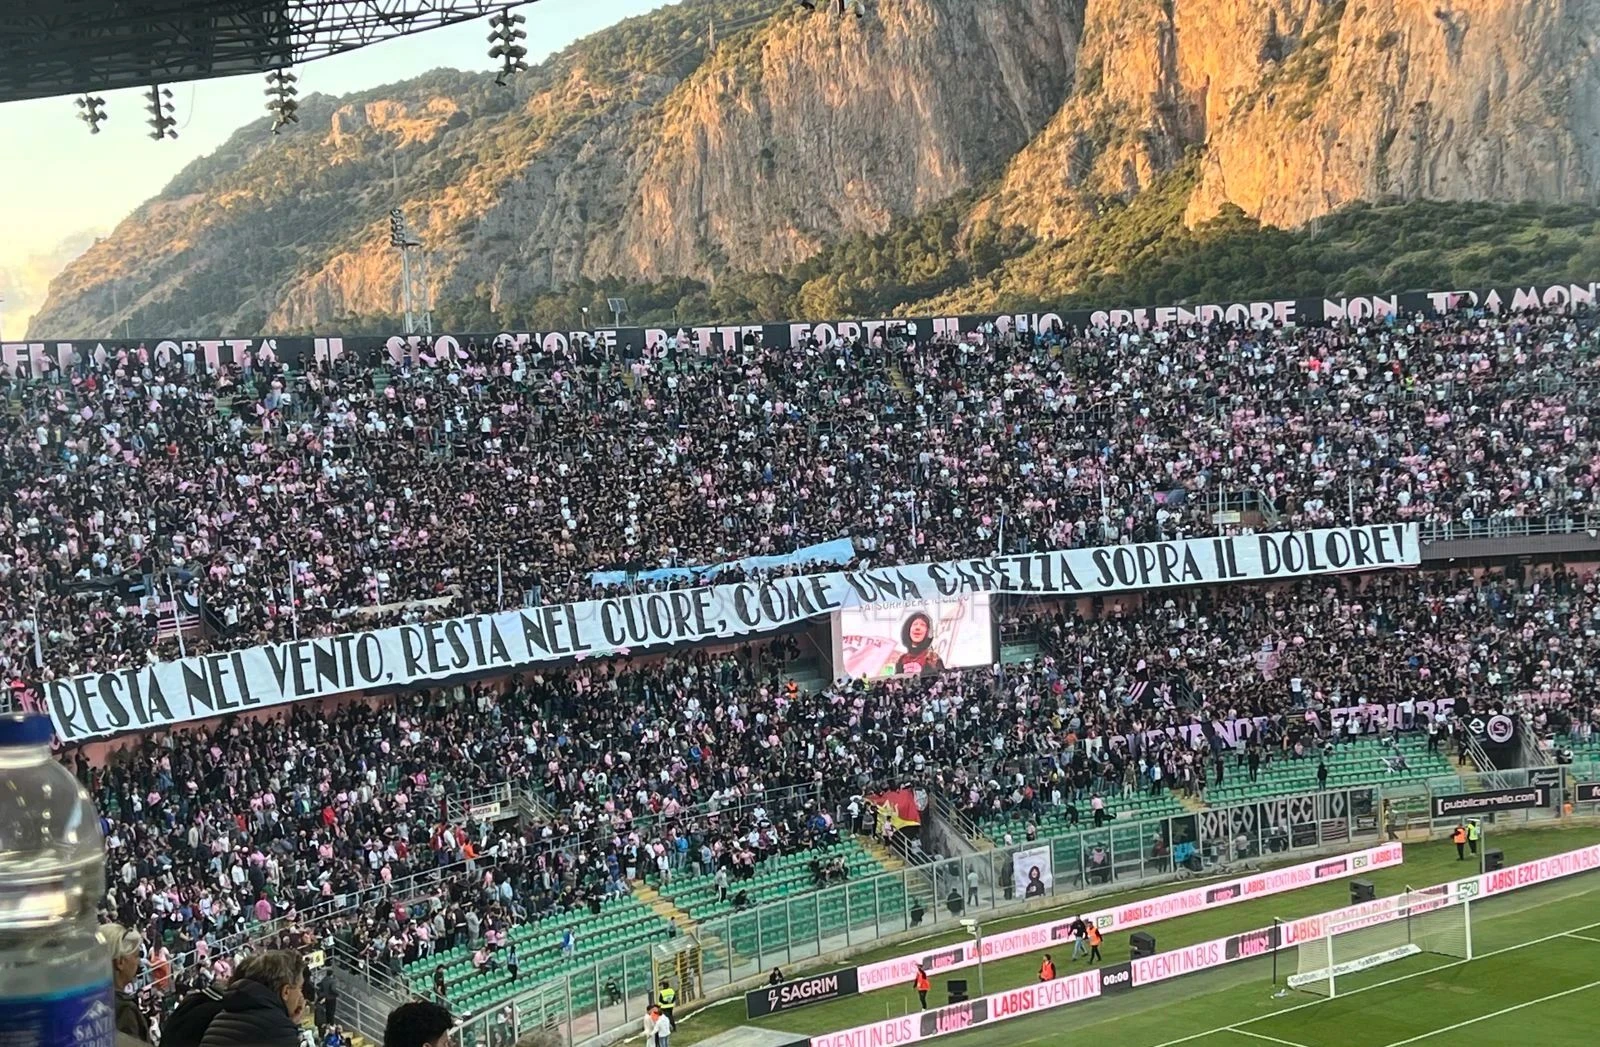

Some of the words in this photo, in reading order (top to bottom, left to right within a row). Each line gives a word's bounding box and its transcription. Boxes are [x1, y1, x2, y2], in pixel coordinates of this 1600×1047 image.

[314, 337, 343, 370] IL
[645, 325, 764, 359] BATTE
[790, 319, 907, 353] FORTE
[932, 317, 959, 338] IL
[1090, 300, 1296, 331] SPLENDORE
[1323, 294, 1398, 322] NON
[51, 665, 175, 738] RESTA
[181, 652, 261, 715] NEL
[264, 632, 394, 698] VENTO,
[402, 615, 511, 676] RESTA
[521, 605, 592, 657] NEL
[734, 575, 841, 627] COME
[845, 567, 923, 603] UNA
[927, 553, 1083, 596] CAREZZA
[1097, 542, 1203, 588] SOPRA
[1213, 535, 1248, 579] IL
[1259, 525, 1405, 575] DOLORE!
[1200, 805, 1254, 840] BORGO
[1372, 850, 1392, 865] LABISI
[1486, 871, 1515, 893] LABISI
[1540, 855, 1571, 879] EVENTI
[1572, 853, 1581, 869] IN
[1583, 847, 1600, 868] BUS
[1243, 878, 1265, 894] LABISI
[1119, 908, 1142, 924] LABISI
[1154, 899, 1178, 916] EVENTI
[994, 936, 1021, 954] EVENTI
[1032, 930, 1047, 945] BUS
[1286, 917, 1320, 943] LABISI
[1140, 952, 1181, 981] EVENTI
[1183, 949, 1194, 969] IN
[1197, 943, 1219, 966] BUS
[781, 975, 838, 1003] SAGRIM
[860, 965, 890, 987] EVENTI
[1103, 971, 1129, 986] 00:00
[994, 990, 1034, 1018] LABISI
[1037, 978, 1081, 1007] EVENTI
[1083, 975, 1094, 996] IN
[886, 1019, 912, 1046] BUS
